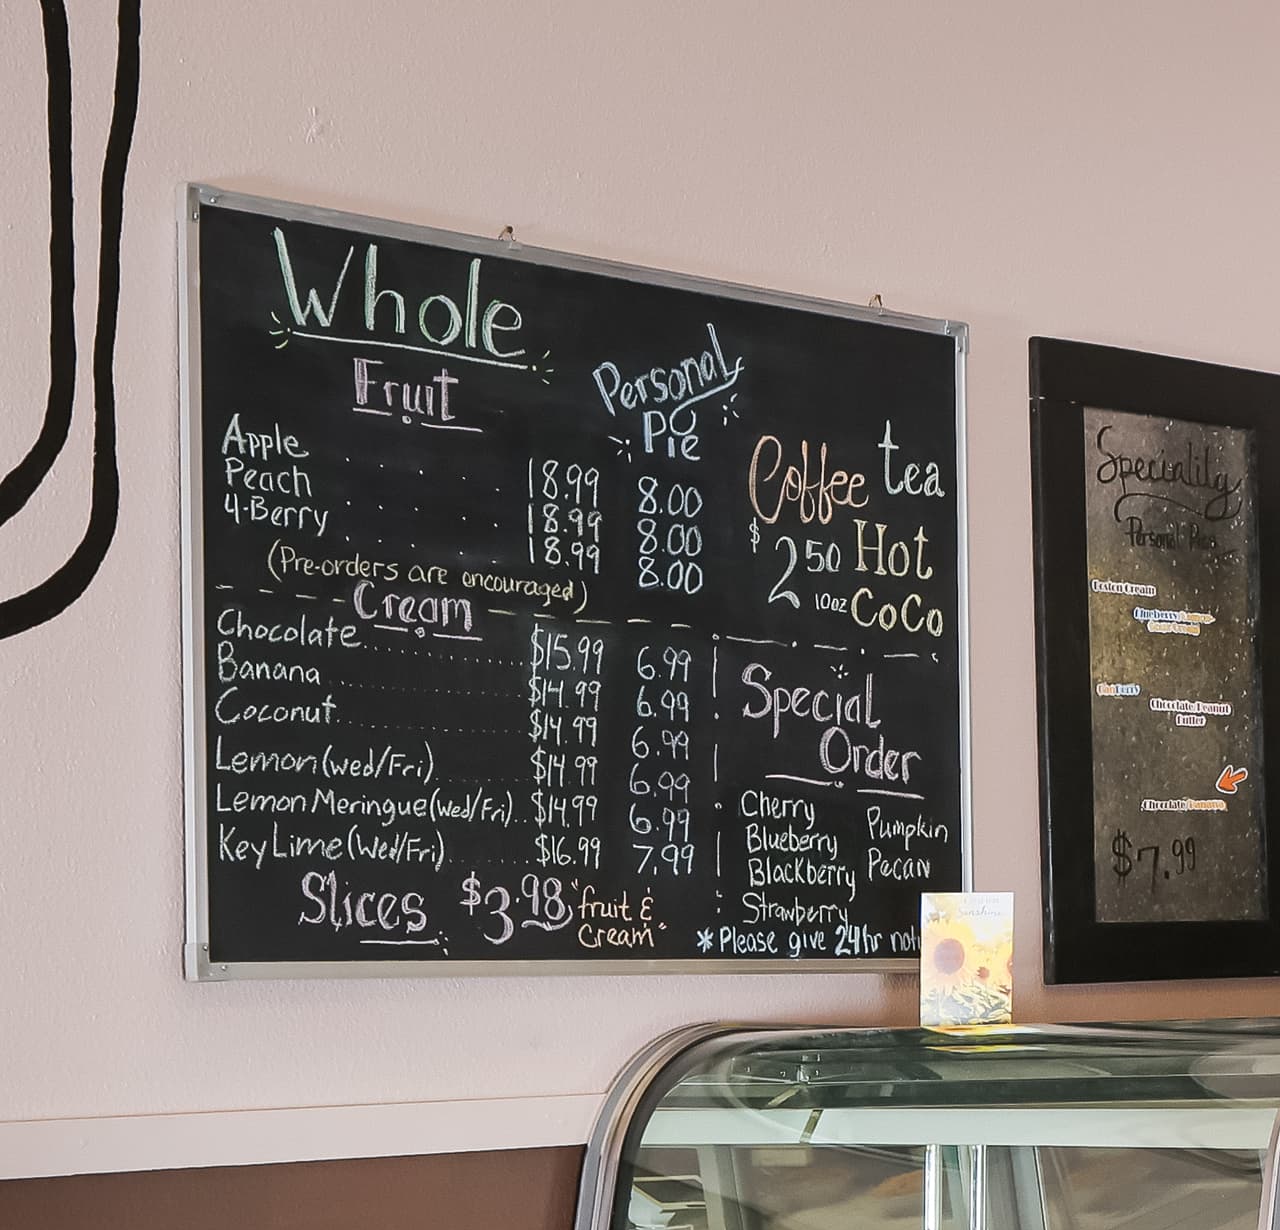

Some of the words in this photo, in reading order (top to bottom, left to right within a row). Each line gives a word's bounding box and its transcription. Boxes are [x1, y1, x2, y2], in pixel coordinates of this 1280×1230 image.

[271, 226, 526, 358] Whole
[353, 358, 459, 421] Fruit
[592, 322, 743, 416] Personal
[222, 413, 310, 460] Apple
[528, 457, 600, 508] 18.99
[637, 476, 702, 518] 8.00
[642, 410, 701, 461] Pie
[748, 435, 869, 525] Coffee
[878, 419, 946, 498] tea
[225, 457, 313, 497] Peach
[528, 503, 602, 543] 18.99
[637, 518, 702, 556] 8.00
[224, 493, 329, 536] 4-Berry
[529, 536, 600, 574] 18.99
[638, 557, 703, 594] 8.00
[853, 518, 933, 580] Hot
[267, 539, 399, 582] (Pre-orders
[408, 565, 448, 584] are
[462, 569, 588, 614] encouraged)
[352, 580, 473, 631] Cream
[216, 608, 362, 648] Chocolate
[530, 623, 604, 675] $15.99
[637, 646, 692, 682] 6.99
[217, 639, 321, 686] Banana
[637, 685, 689, 722] 6.99
[742, 662, 882, 739] Special
[214, 686, 337, 724] Coconut
[528, 708, 597, 748] $14.99
[632, 725, 689, 760] 6.99
[819, 726, 922, 784] Order
[214, 736, 318, 776] Lemon
[530, 745, 598, 787] $14.99
[629, 763, 690, 804] 6.99
[216, 783, 307, 813] Lemon
[310, 787, 427, 827] Meringue
[531, 787, 598, 828] $14.99
[629, 803, 690, 842] 6.99
[741, 791, 815, 830] Cherry
[746, 823, 838, 860] Blueberry
[866, 806, 948, 852] Pumpkin
[219, 823, 267, 869] Key
[272, 821, 343, 860] Lime
[535, 832, 601, 869] $16.99
[632, 844, 695, 875] 7.99
[748, 857, 856, 902] Blackberry
[1111, 828, 1198, 893] $7.99
[299, 869, 428, 934] Slices
[742, 892, 849, 927] Strawberry
[789, 932, 826, 958] give
[835, 924, 883, 956] 24hr
